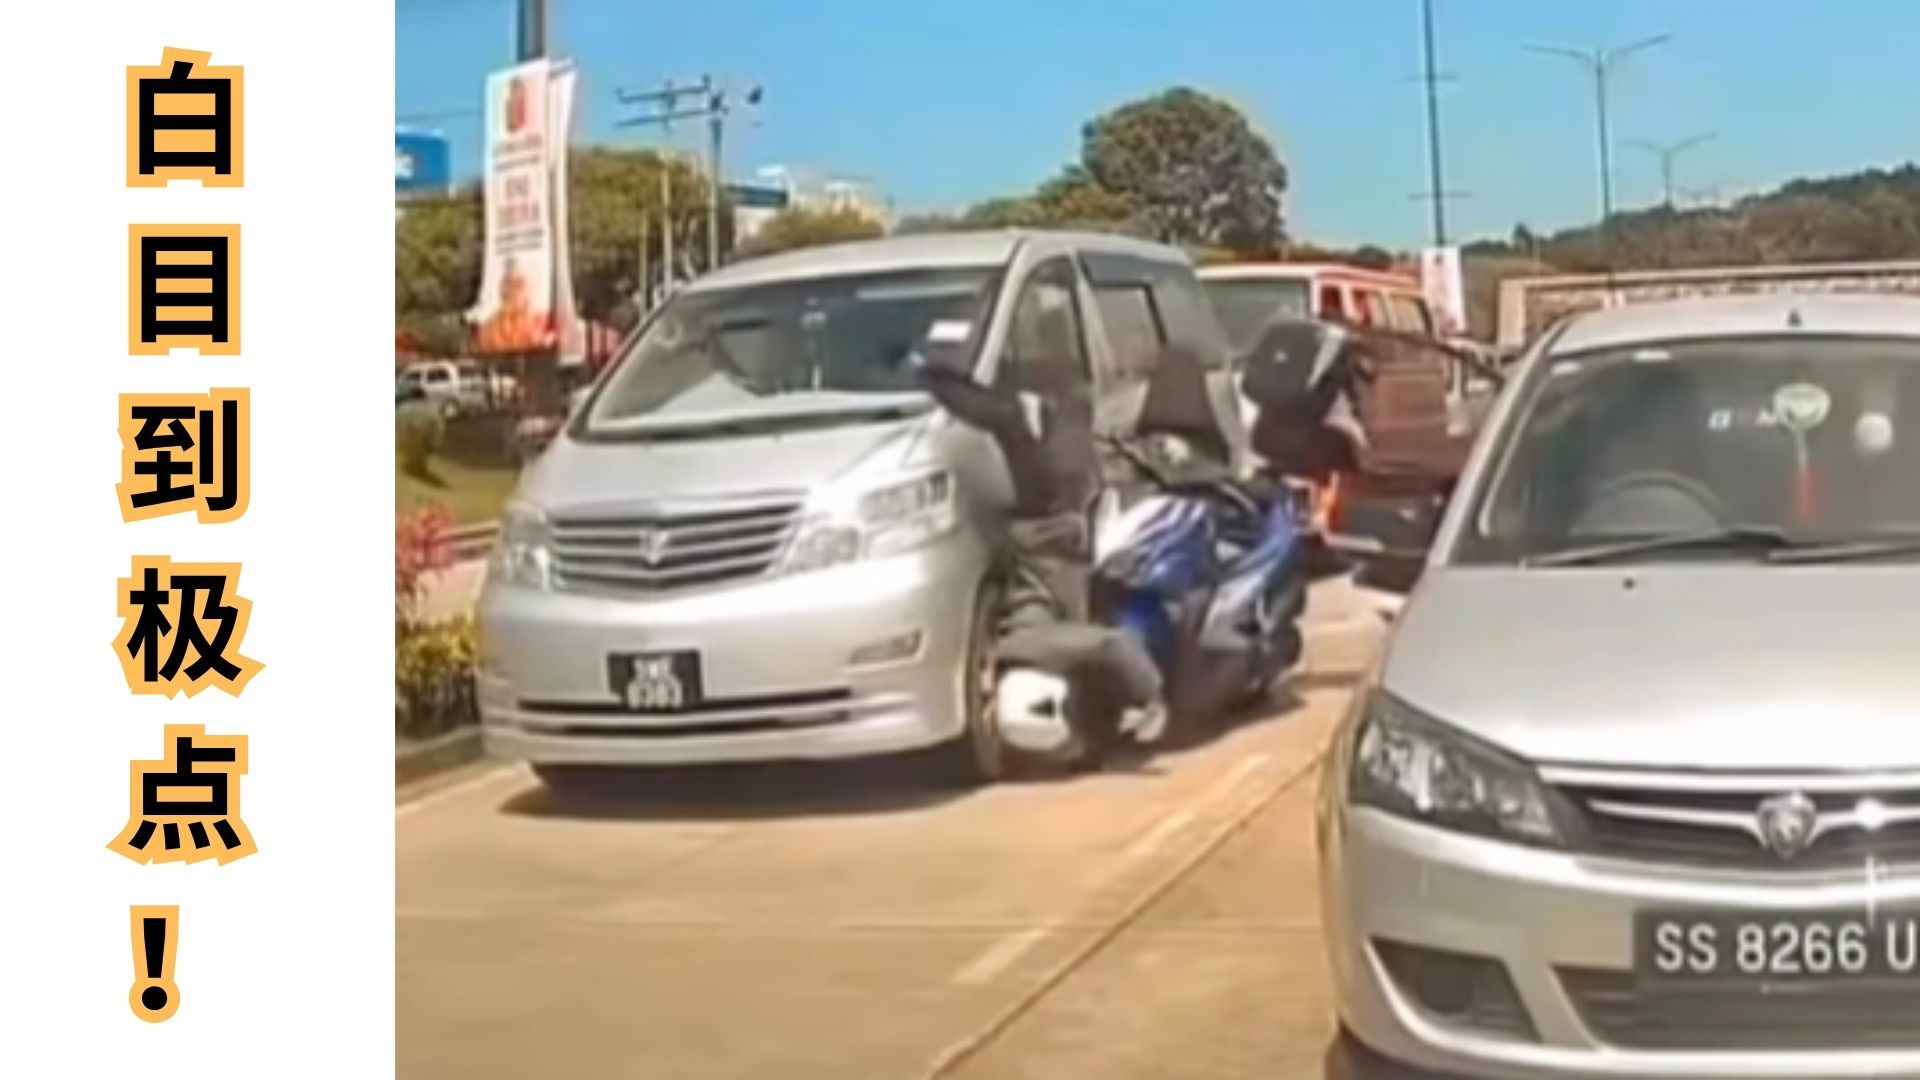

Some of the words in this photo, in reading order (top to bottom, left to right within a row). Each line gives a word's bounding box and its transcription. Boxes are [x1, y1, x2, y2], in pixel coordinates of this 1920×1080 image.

[1655, 921, 1718, 972] SS
[1735, 921, 1868, 973] 8266
[1885, 917, 1918, 972] U
